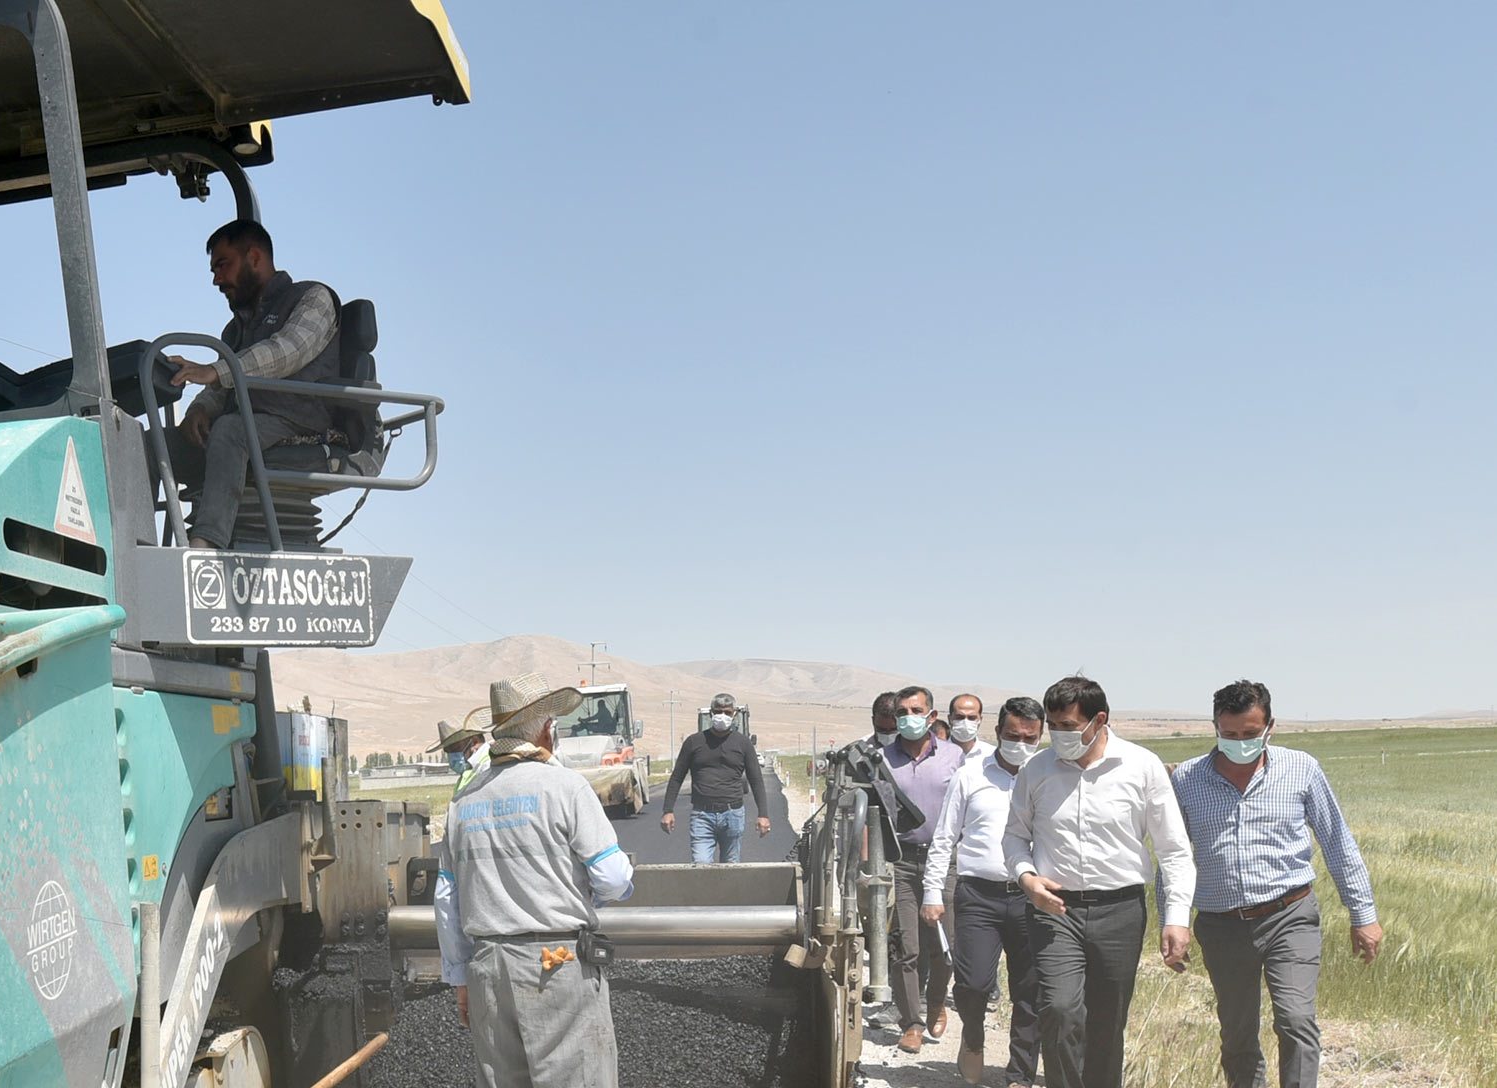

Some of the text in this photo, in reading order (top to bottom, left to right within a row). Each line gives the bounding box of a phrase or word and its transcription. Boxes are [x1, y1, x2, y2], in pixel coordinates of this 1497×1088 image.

[210, 615, 364, 633] 233 87 10 KONYA
[26, 907, 75, 949] WIRTGEN
[32, 938, 73, 973] GROUP
